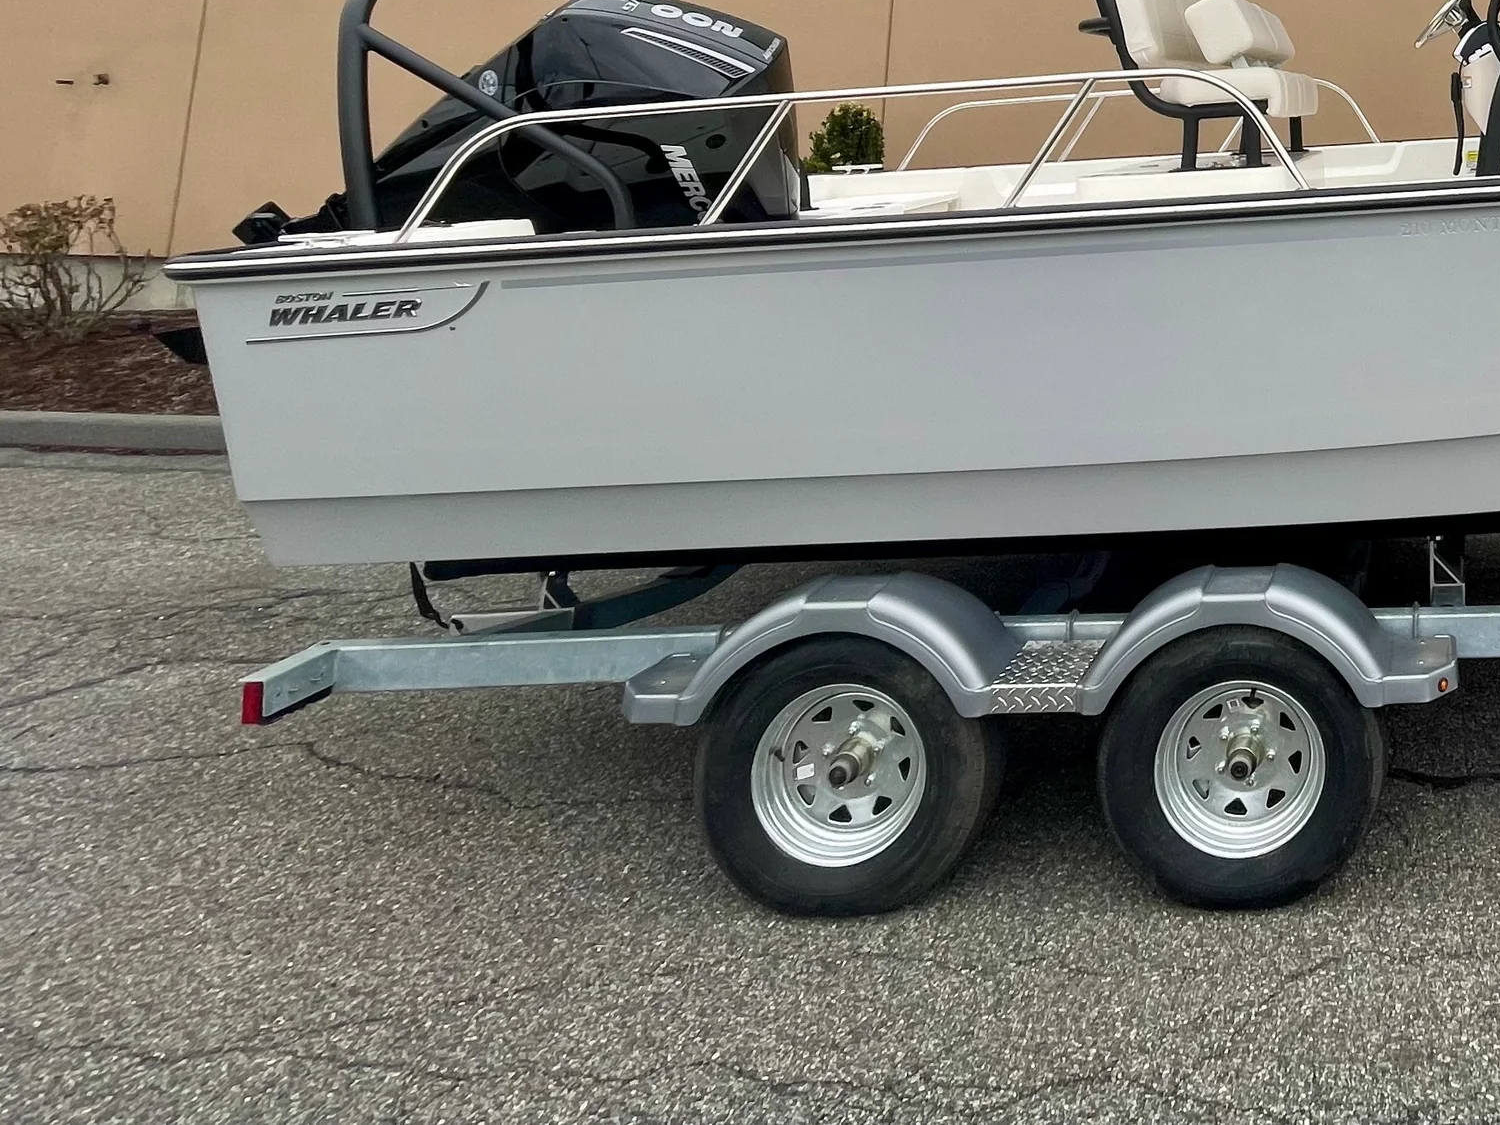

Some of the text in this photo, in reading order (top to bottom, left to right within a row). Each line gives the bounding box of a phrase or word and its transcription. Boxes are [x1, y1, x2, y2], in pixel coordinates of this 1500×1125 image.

[651, 4, 744, 38] 200
[660, 144, 713, 221] MERC
[1400, 221, 1431, 238] 210
[268, 298, 422, 327] WHALER
[274, 291, 335, 305] BOSTON
